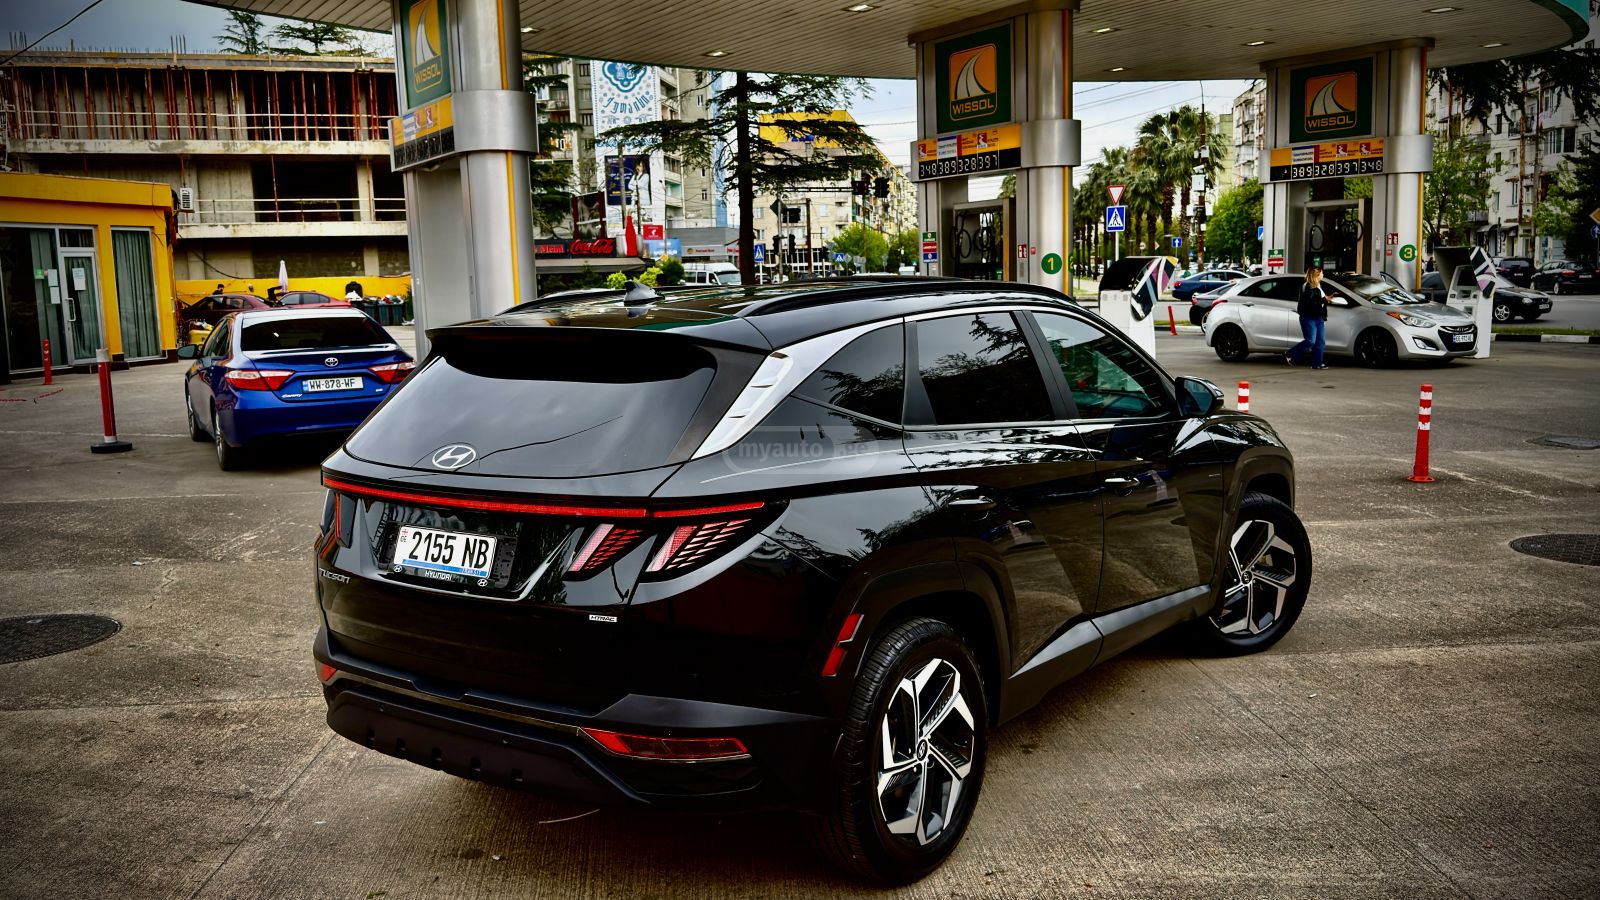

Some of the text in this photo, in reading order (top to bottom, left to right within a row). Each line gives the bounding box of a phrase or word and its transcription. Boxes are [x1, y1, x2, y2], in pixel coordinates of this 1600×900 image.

[415, 63, 441, 85] WISSOL
[952, 98, 994, 115] WISSOL
[1308, 115, 1354, 128] WISSOL
[920, 154, 998, 177] 348 389 328 397
[1292, 166, 1312, 178] 389
[1337, 162, 1358, 174] 397
[1403, 247, 1413, 259] 3
[1047, 257, 1054, 271] 1
[309, 378, 356, 390] WW-878-WF
[408, 531, 489, 569] 2155 NB
[318, 567, 350, 584] TUCSON
[424, 569, 453, 581] HYUNDAI
